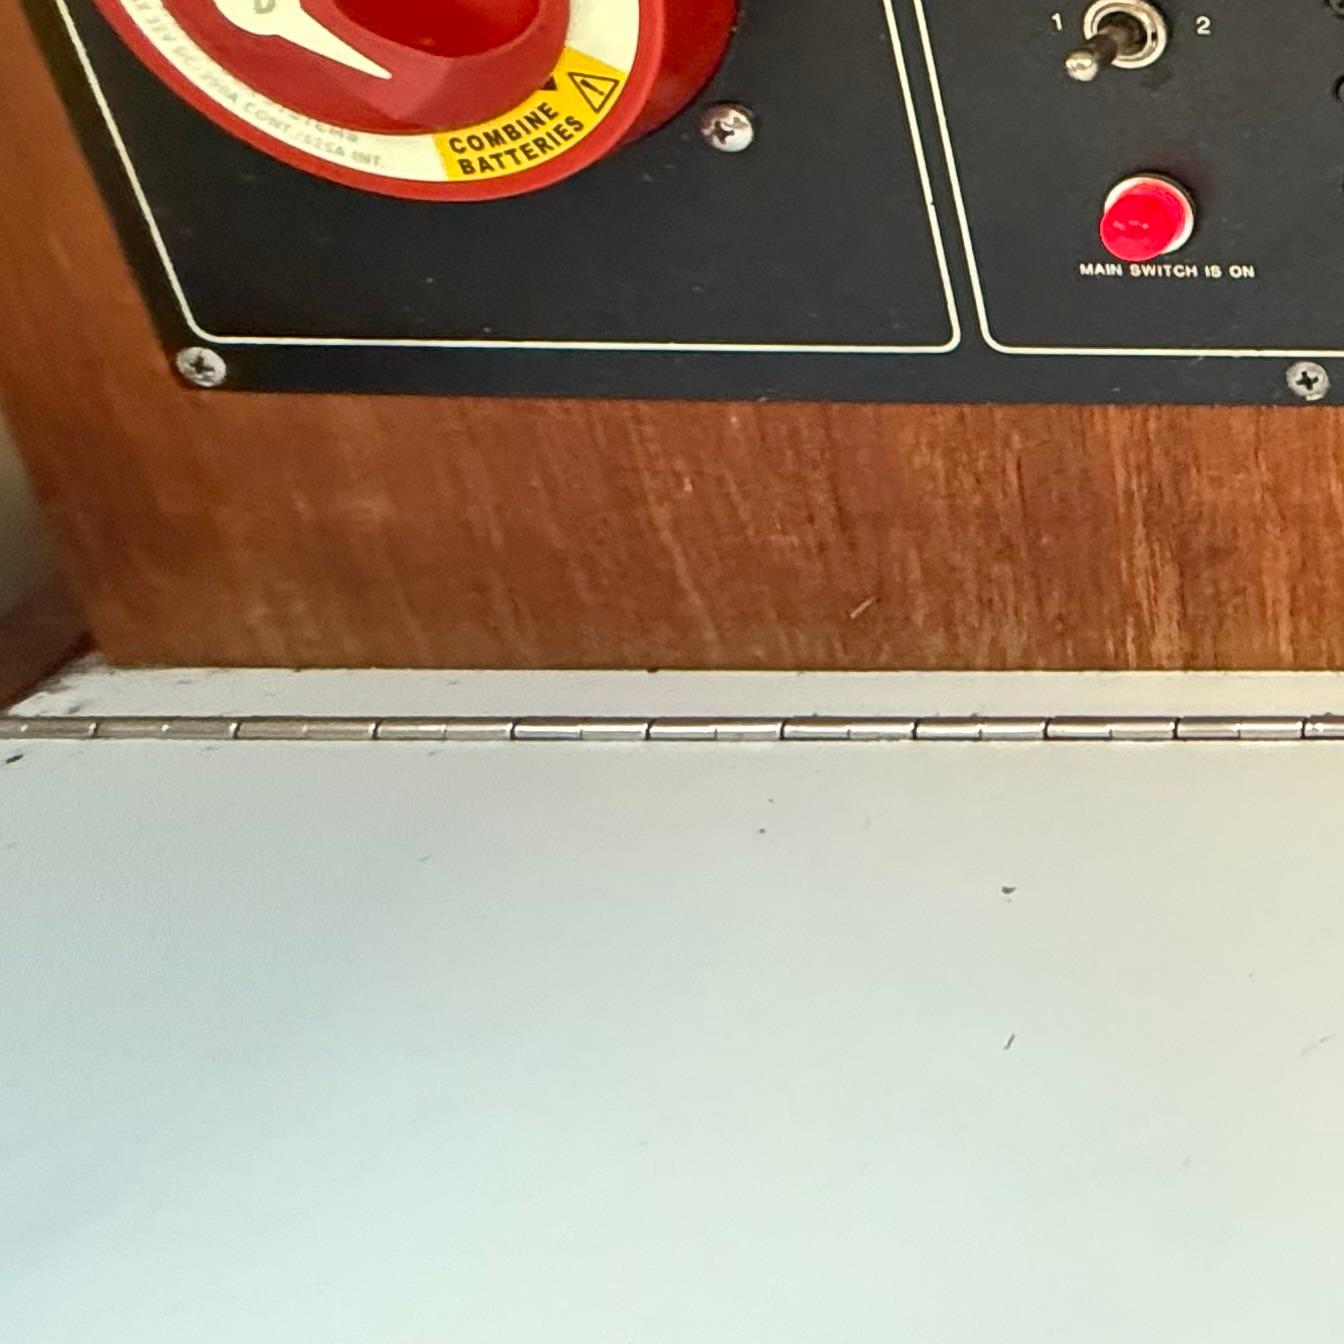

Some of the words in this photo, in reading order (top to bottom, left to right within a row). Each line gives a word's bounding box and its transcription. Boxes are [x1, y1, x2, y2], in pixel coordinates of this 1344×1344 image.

[1051, 13, 1063, 31] 1
[1196, 16, 1211, 34] 2
[449, 102, 558, 154] COMBINE
[458, 116, 584, 175] BATTERIES
[1080, 264, 1122, 276] MAIN
[1130, 264, 1198, 277] SWITCH
[1205, 265, 1222, 277] IS
[1229, 265, 1255, 278] ON
